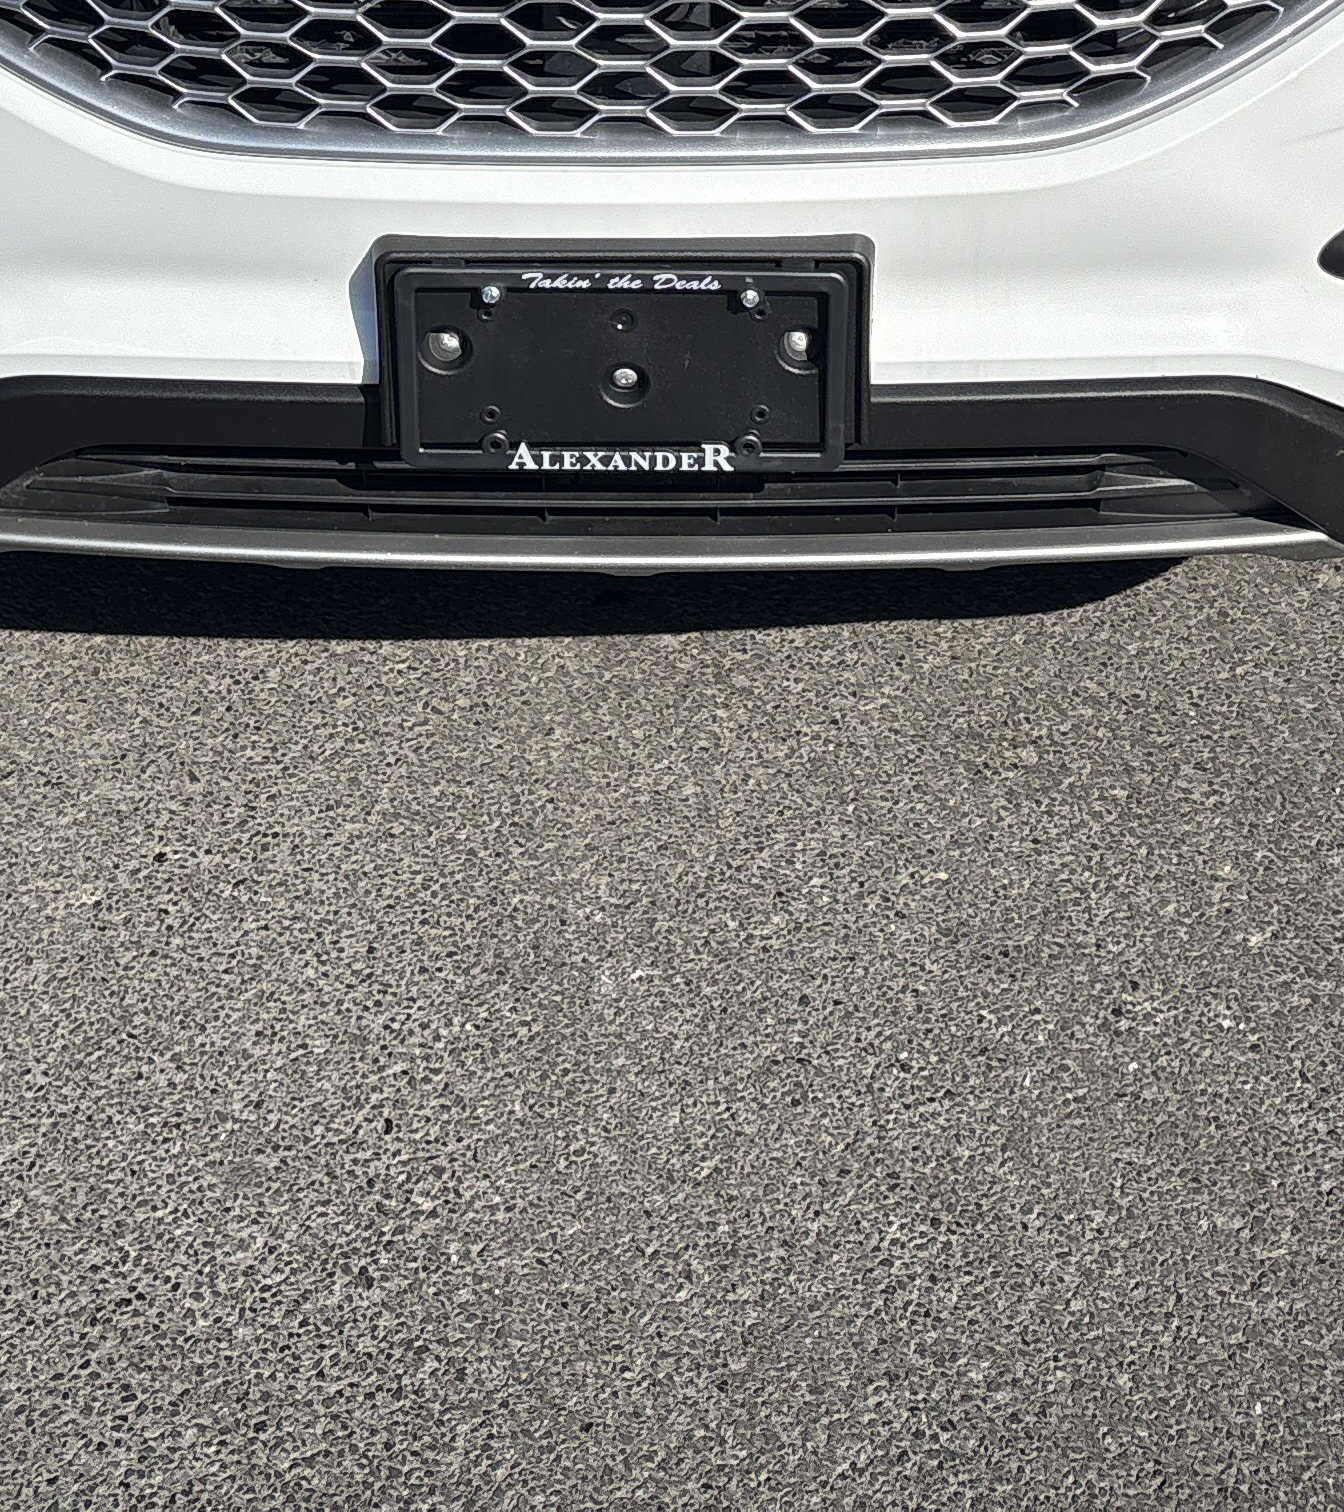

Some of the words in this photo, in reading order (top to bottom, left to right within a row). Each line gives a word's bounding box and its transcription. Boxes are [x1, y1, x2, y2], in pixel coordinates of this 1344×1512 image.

[521, 272, 601, 289] Takin'
[606, 273, 644, 290] the
[652, 273, 723, 291] Deals
[507, 441, 735, 472] ALEXANDER
